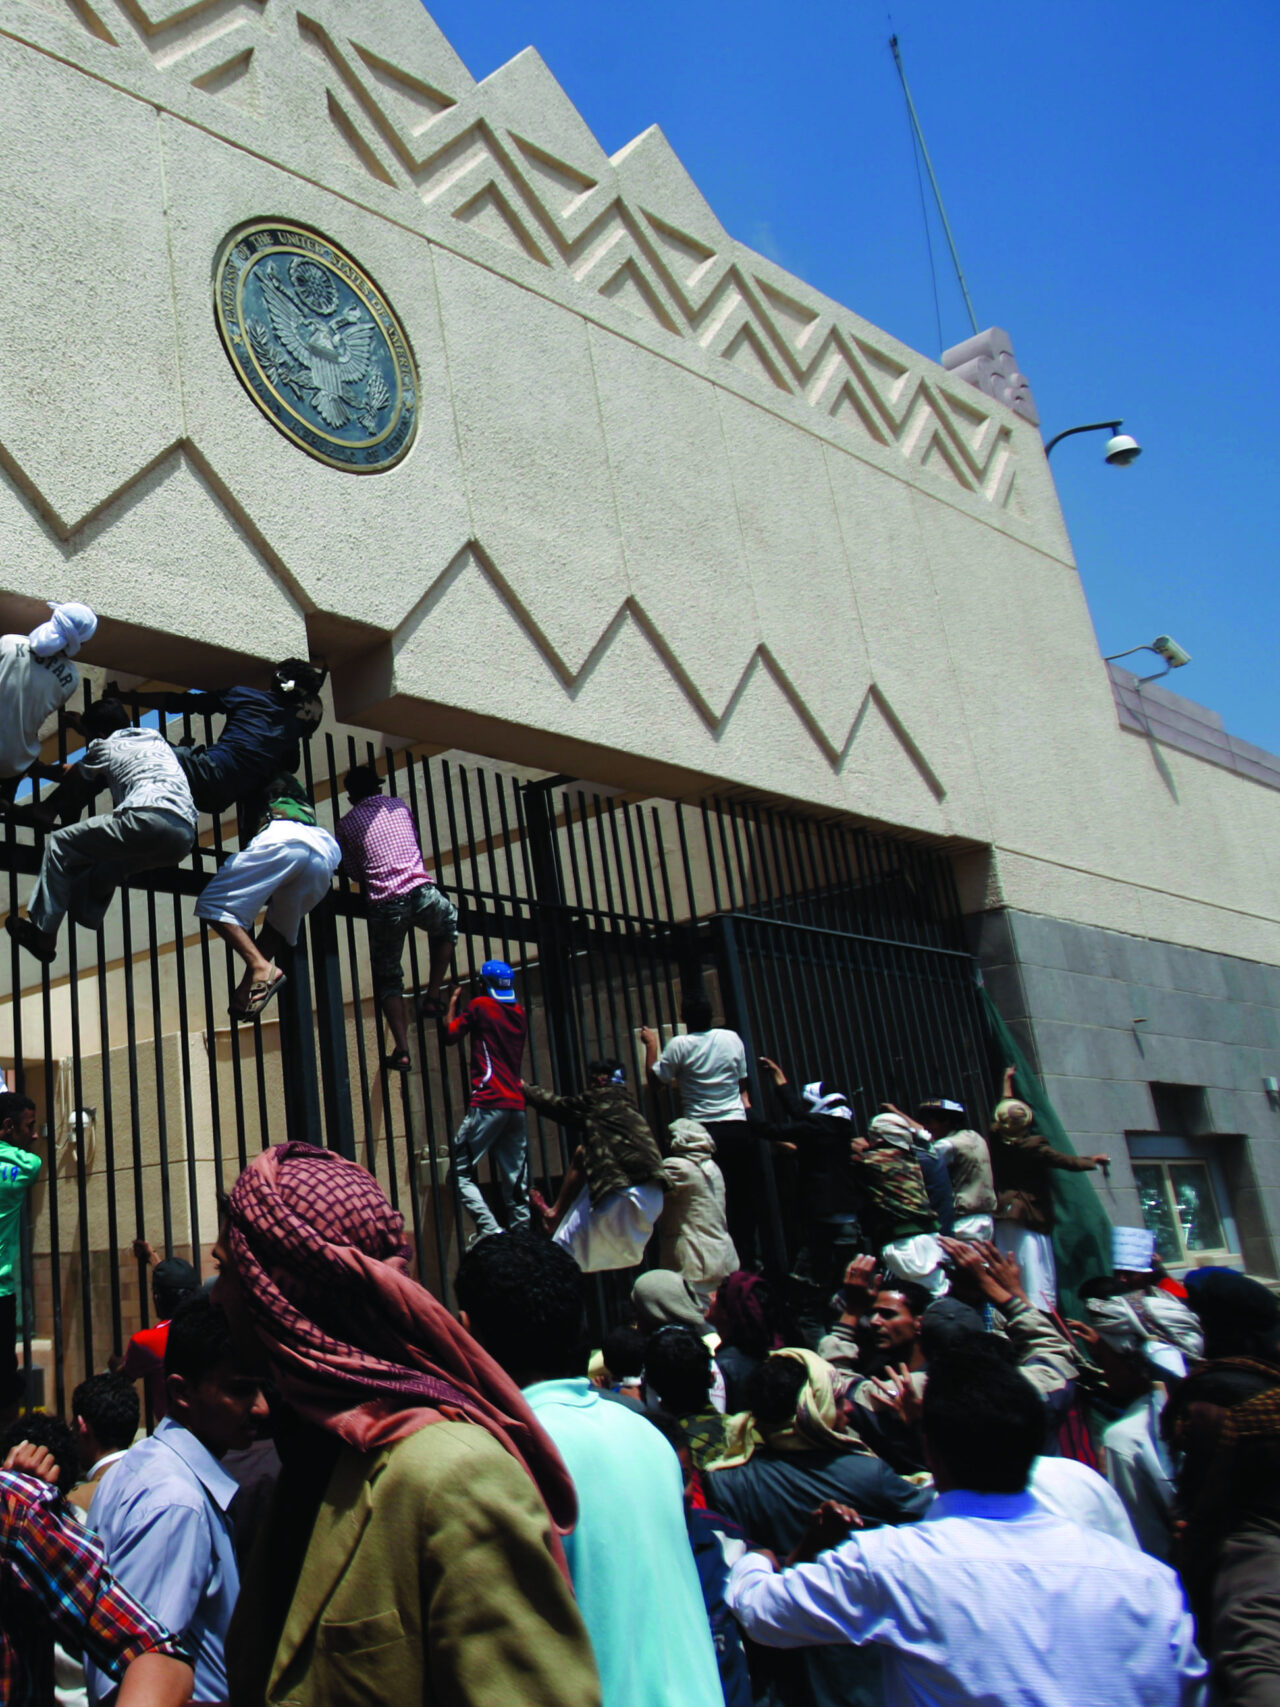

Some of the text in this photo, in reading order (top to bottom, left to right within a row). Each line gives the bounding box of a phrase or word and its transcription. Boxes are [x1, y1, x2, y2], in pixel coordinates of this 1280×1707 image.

[224, 231, 412, 391] EMBASSY OF THE UNITED STATES OF AMERICA
